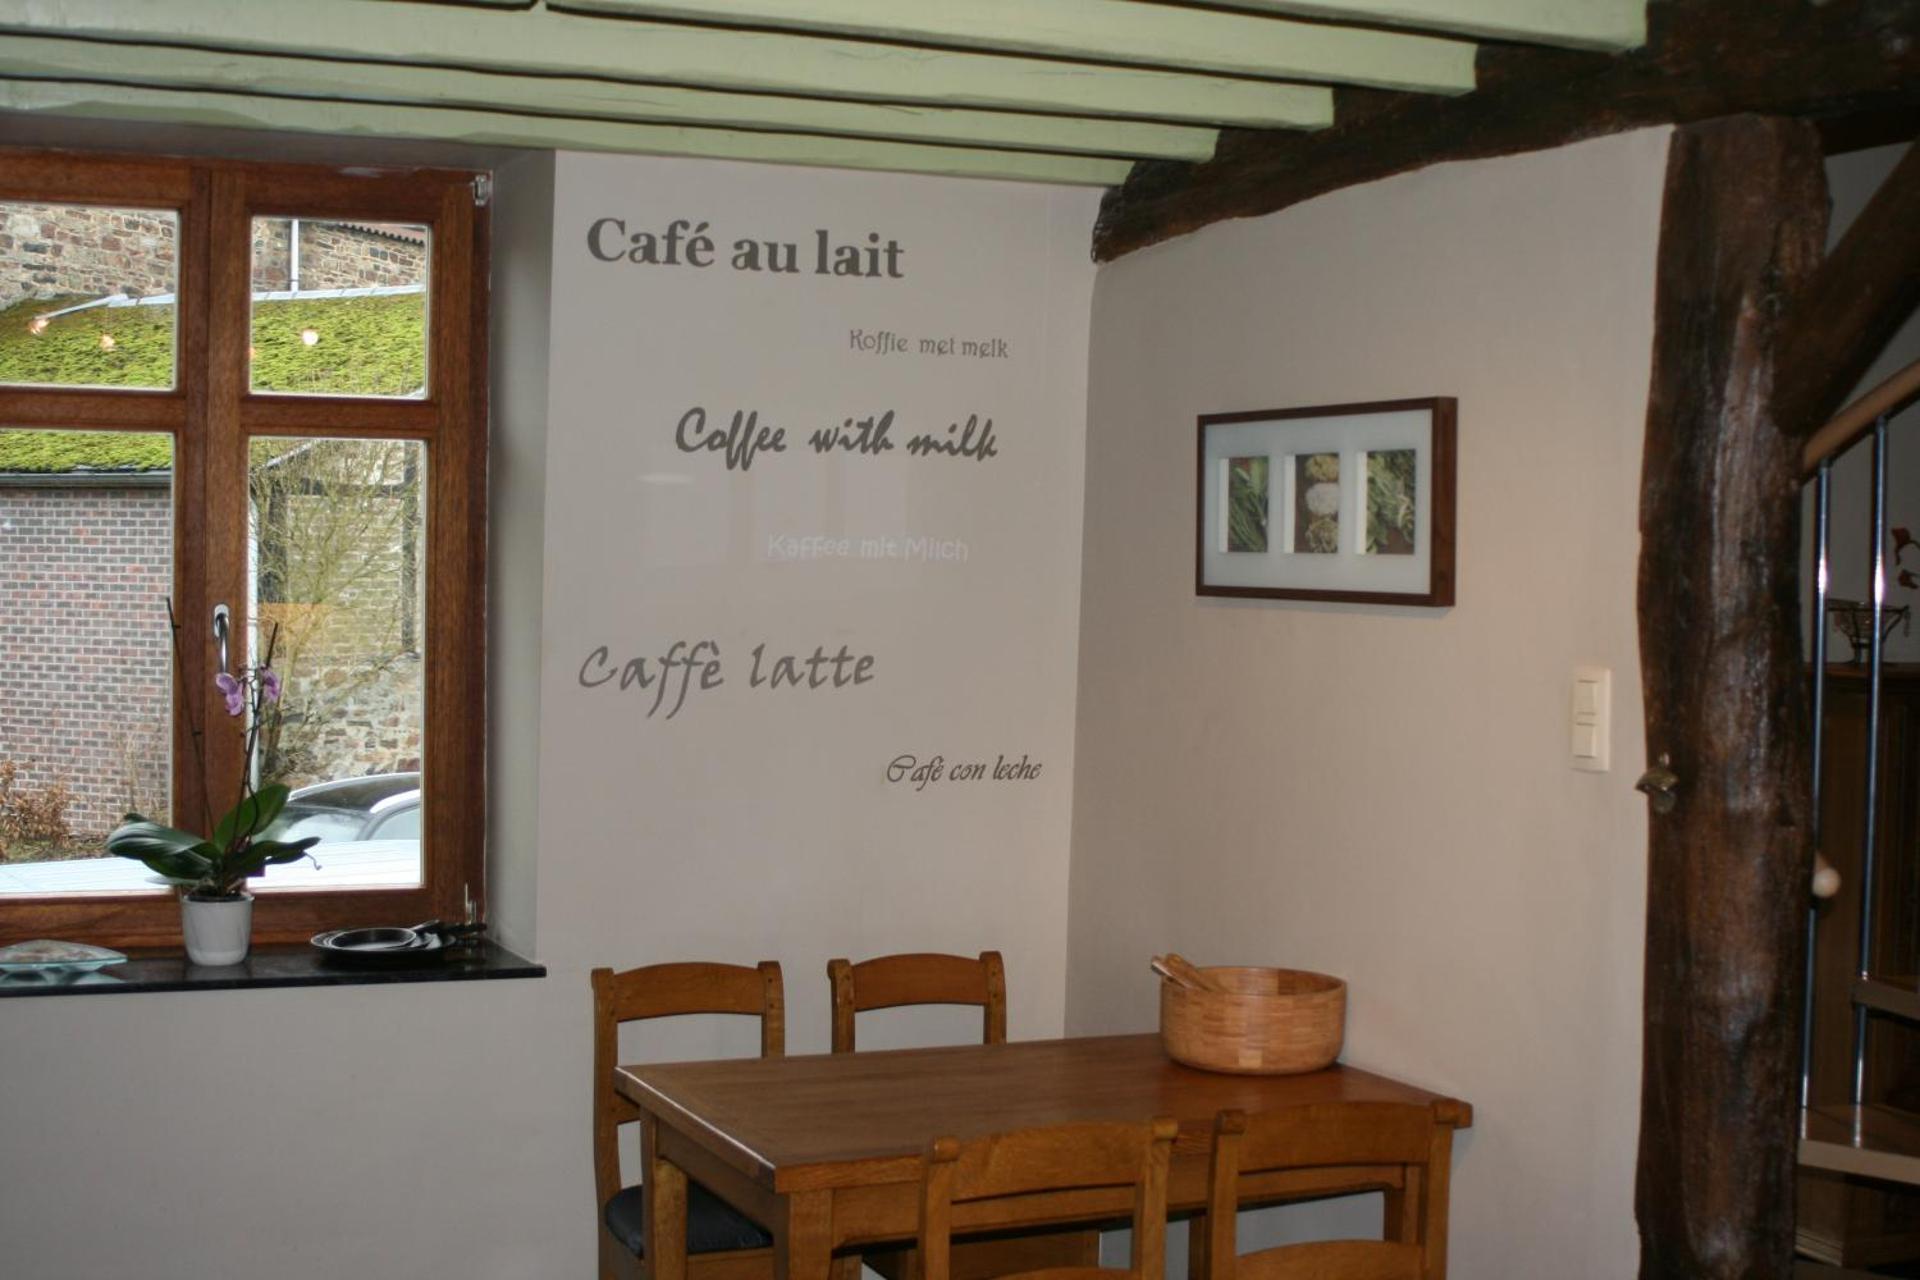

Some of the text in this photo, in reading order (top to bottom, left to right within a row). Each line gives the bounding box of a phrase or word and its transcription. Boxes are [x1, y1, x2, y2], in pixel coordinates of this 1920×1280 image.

[587, 218, 904, 278] Café au lait
[849, 328, 1009, 359] Koffie met melk
[675, 406, 998, 471] Coffee with milk
[767, 534, 849, 559] Kaffee
[903, 538, 970, 563] Milch
[578, 640, 875, 720] Caffè latte
[949, 763, 987, 782] con
[993, 754, 1043, 781] leche
